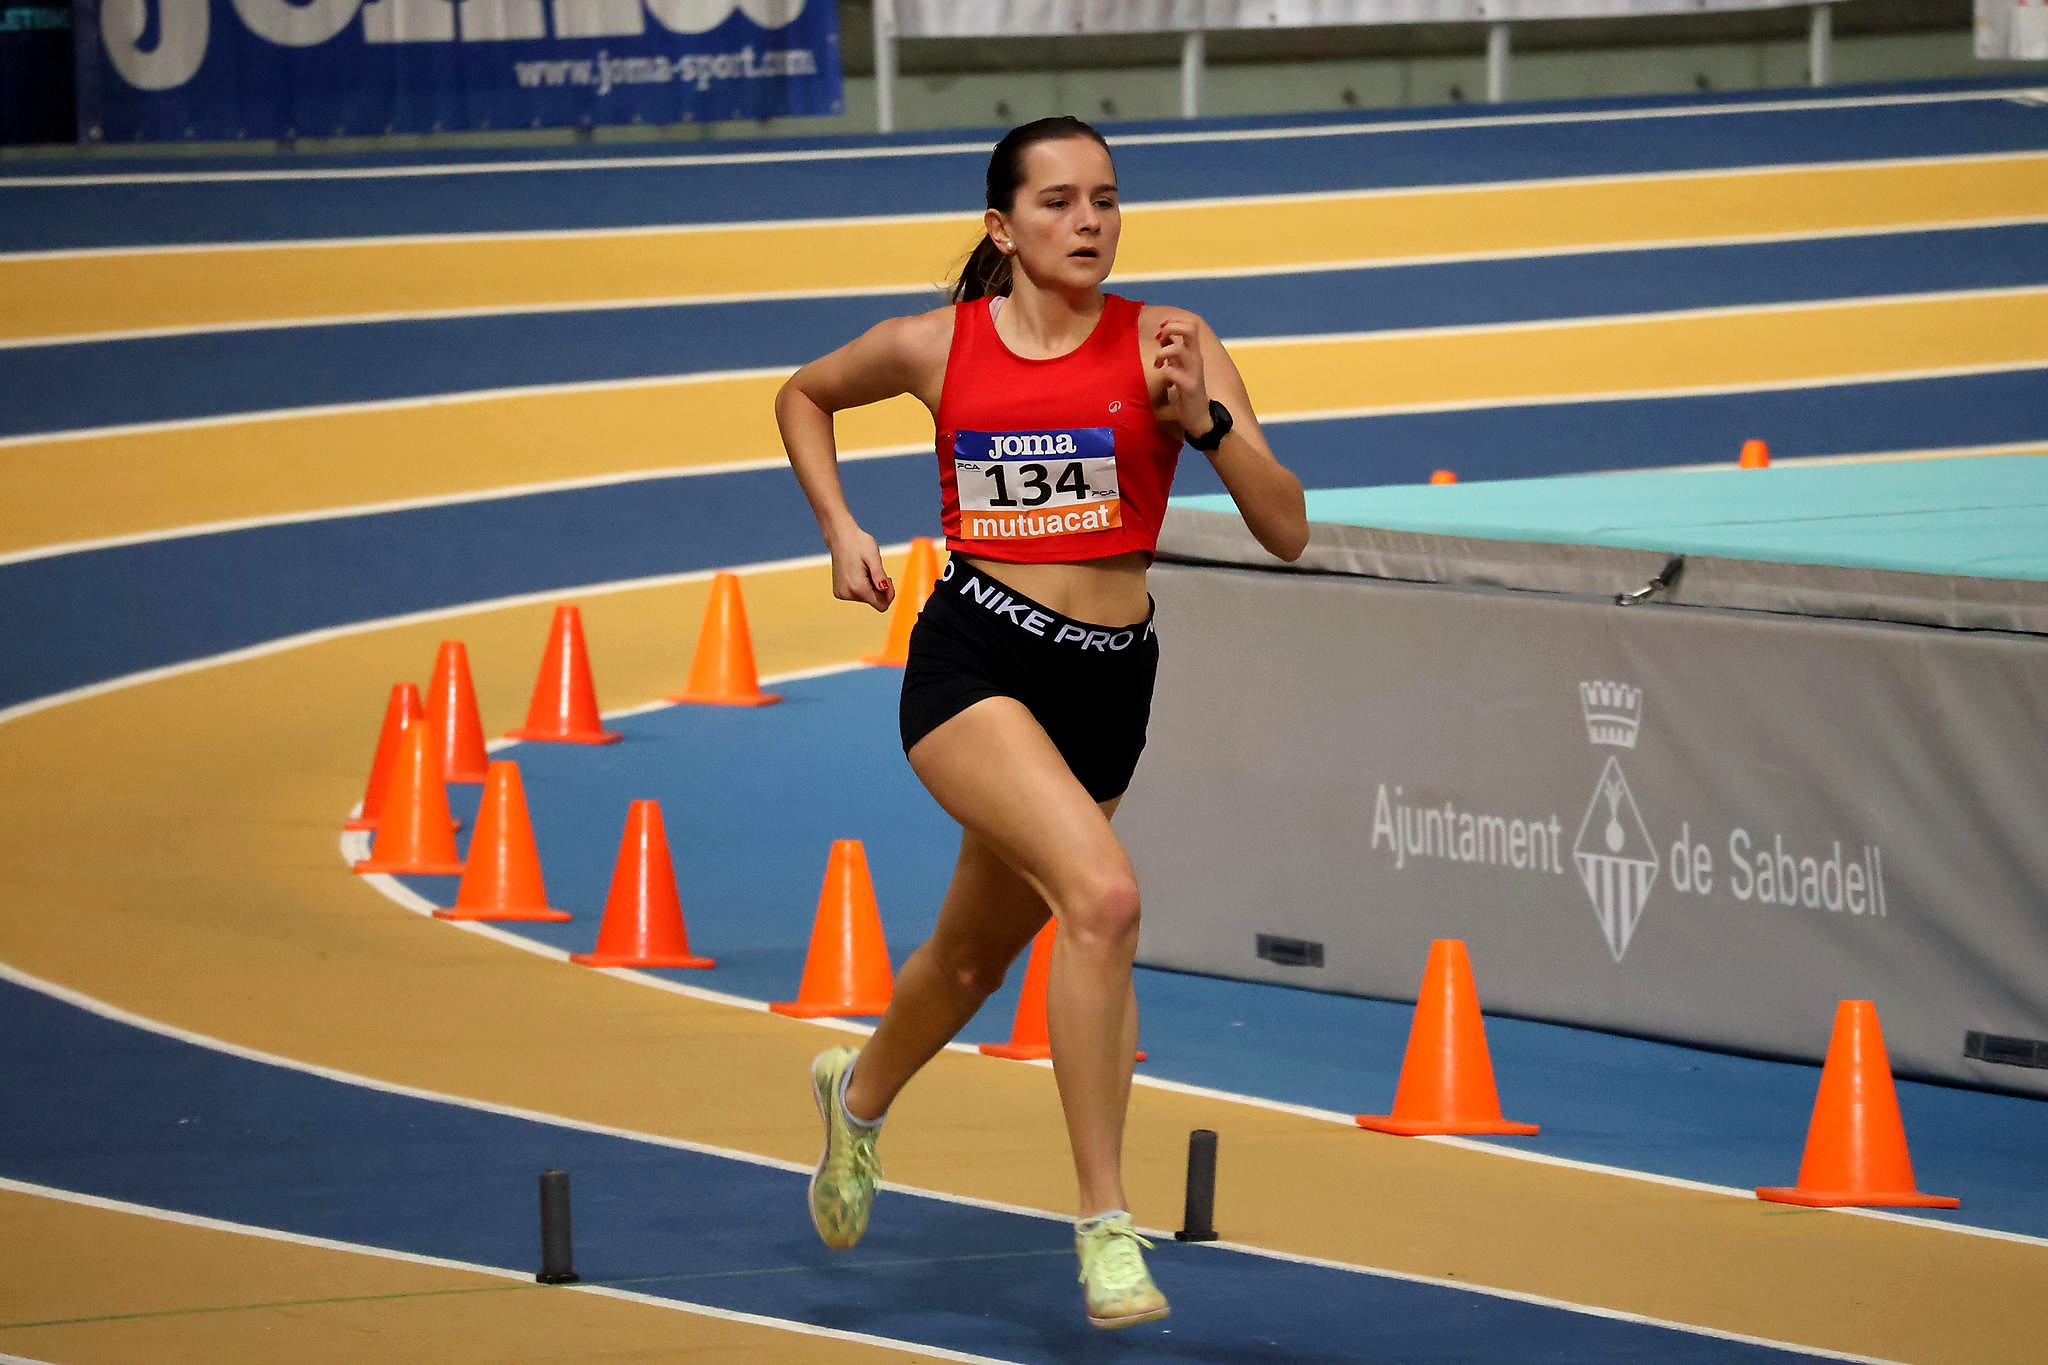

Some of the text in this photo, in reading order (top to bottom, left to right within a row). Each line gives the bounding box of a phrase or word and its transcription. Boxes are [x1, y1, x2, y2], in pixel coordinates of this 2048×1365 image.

[985, 462, 1090, 507] 134
[973, 504, 1110, 537] mutuacat
[960, 576, 1054, 637] NIKE
[1054, 624, 1134, 652] PRO
[1371, 783, 1887, 917] Ajuntament de Sabadell
